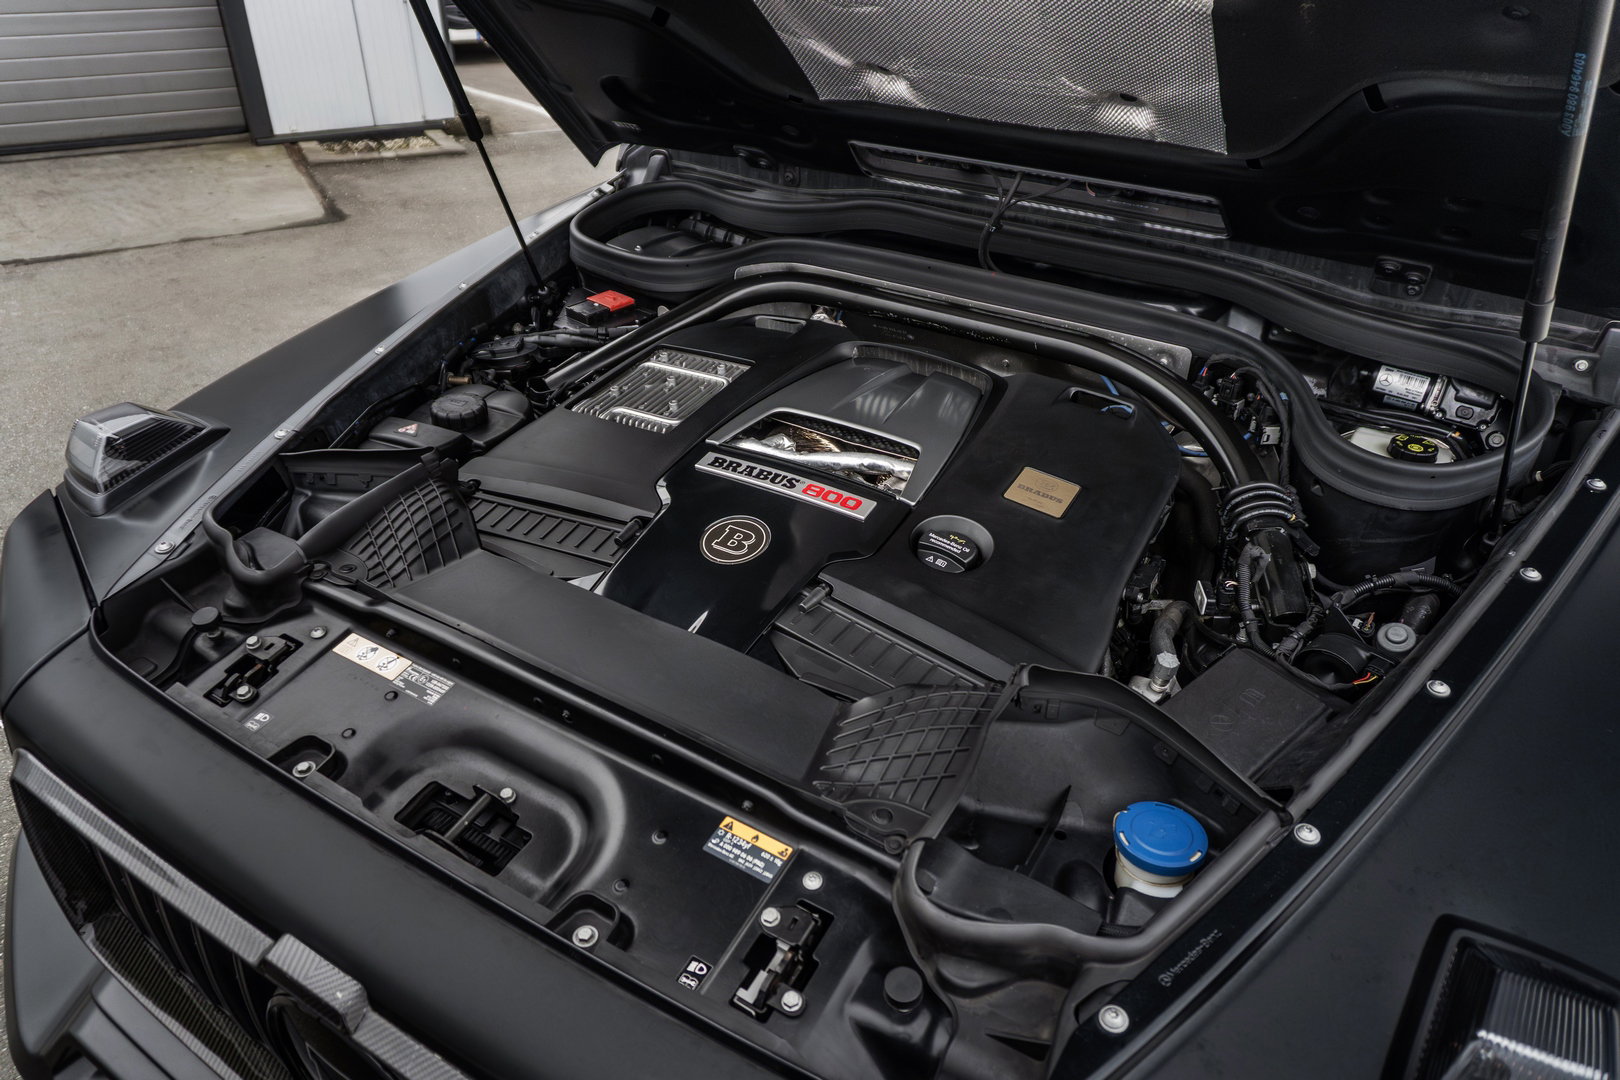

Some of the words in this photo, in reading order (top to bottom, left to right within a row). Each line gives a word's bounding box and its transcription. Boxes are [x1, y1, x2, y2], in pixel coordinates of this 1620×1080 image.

[707, 456, 800, 490] BRABUS
[801, 483, 863, 511] 800
[711, 524, 756, 556] B
[929, 538, 962, 554] recommended
